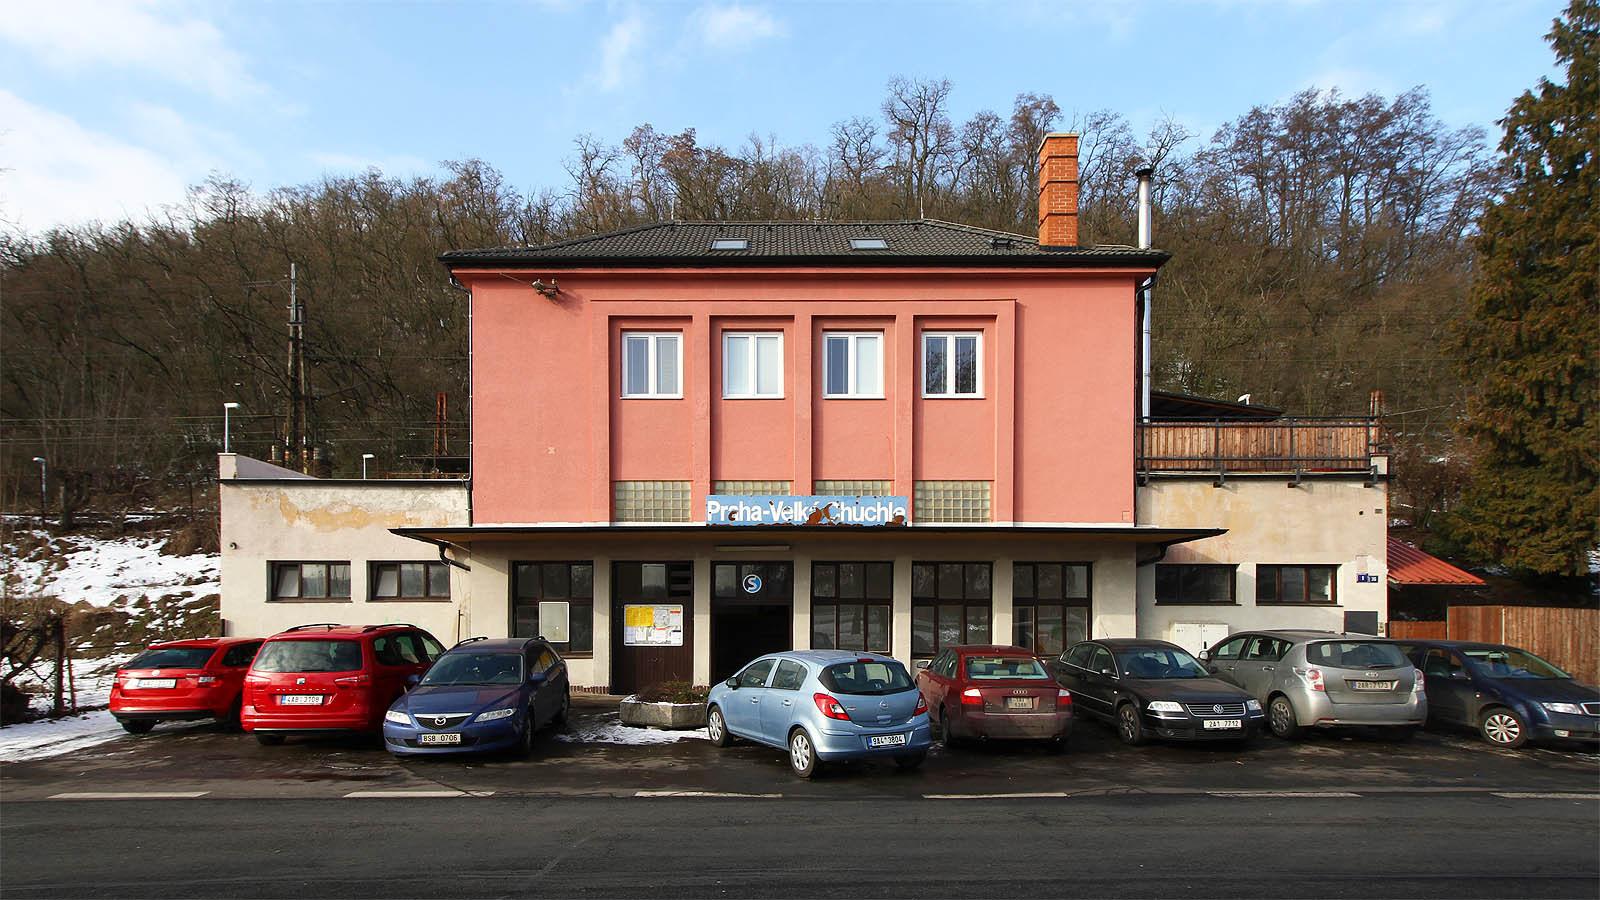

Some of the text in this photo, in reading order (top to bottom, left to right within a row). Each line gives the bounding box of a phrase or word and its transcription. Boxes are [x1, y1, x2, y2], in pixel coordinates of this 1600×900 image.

[823, 501, 906, 523] Chuchle
[440, 734, 458, 742] 0706
[872, 735, 903, 745] 9A4 3804
